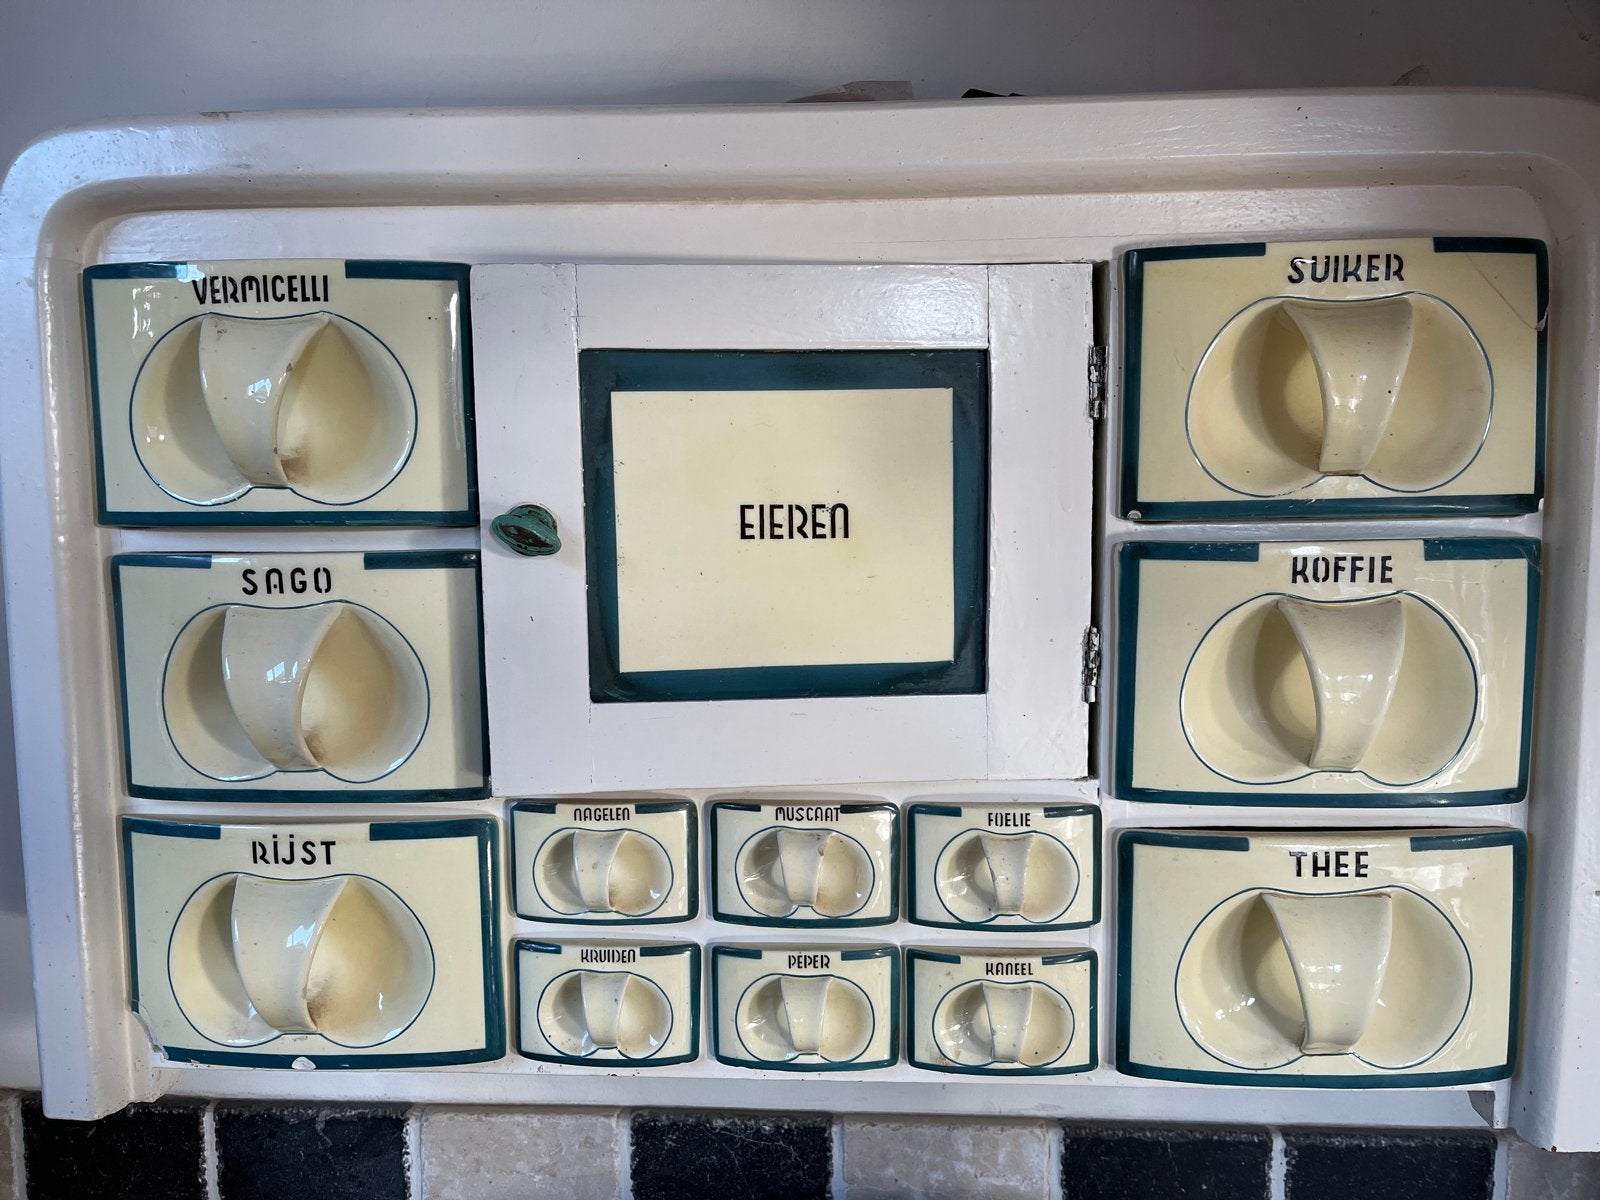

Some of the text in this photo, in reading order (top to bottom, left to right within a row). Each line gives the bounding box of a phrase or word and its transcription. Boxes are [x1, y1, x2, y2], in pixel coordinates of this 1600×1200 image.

[1287, 252, 1406, 285] SUIKER
[190, 273, 330, 306] VERMICELLI
[738, 502, 850, 541] EIEREN
[1291, 554, 1394, 585] KOFFIE
[241, 566, 333, 596] SAGO
[573, 807, 631, 822] NAGELEN
[775, 806, 843, 822] MUSCAAT
[987, 812, 1031, 828] FOELIE
[1288, 851, 1370, 879] THEE
[580, 948, 636, 964] KRUIDEN
[787, 953, 831, 970] PEPER
[985, 961, 1034, 976] KANEEL
